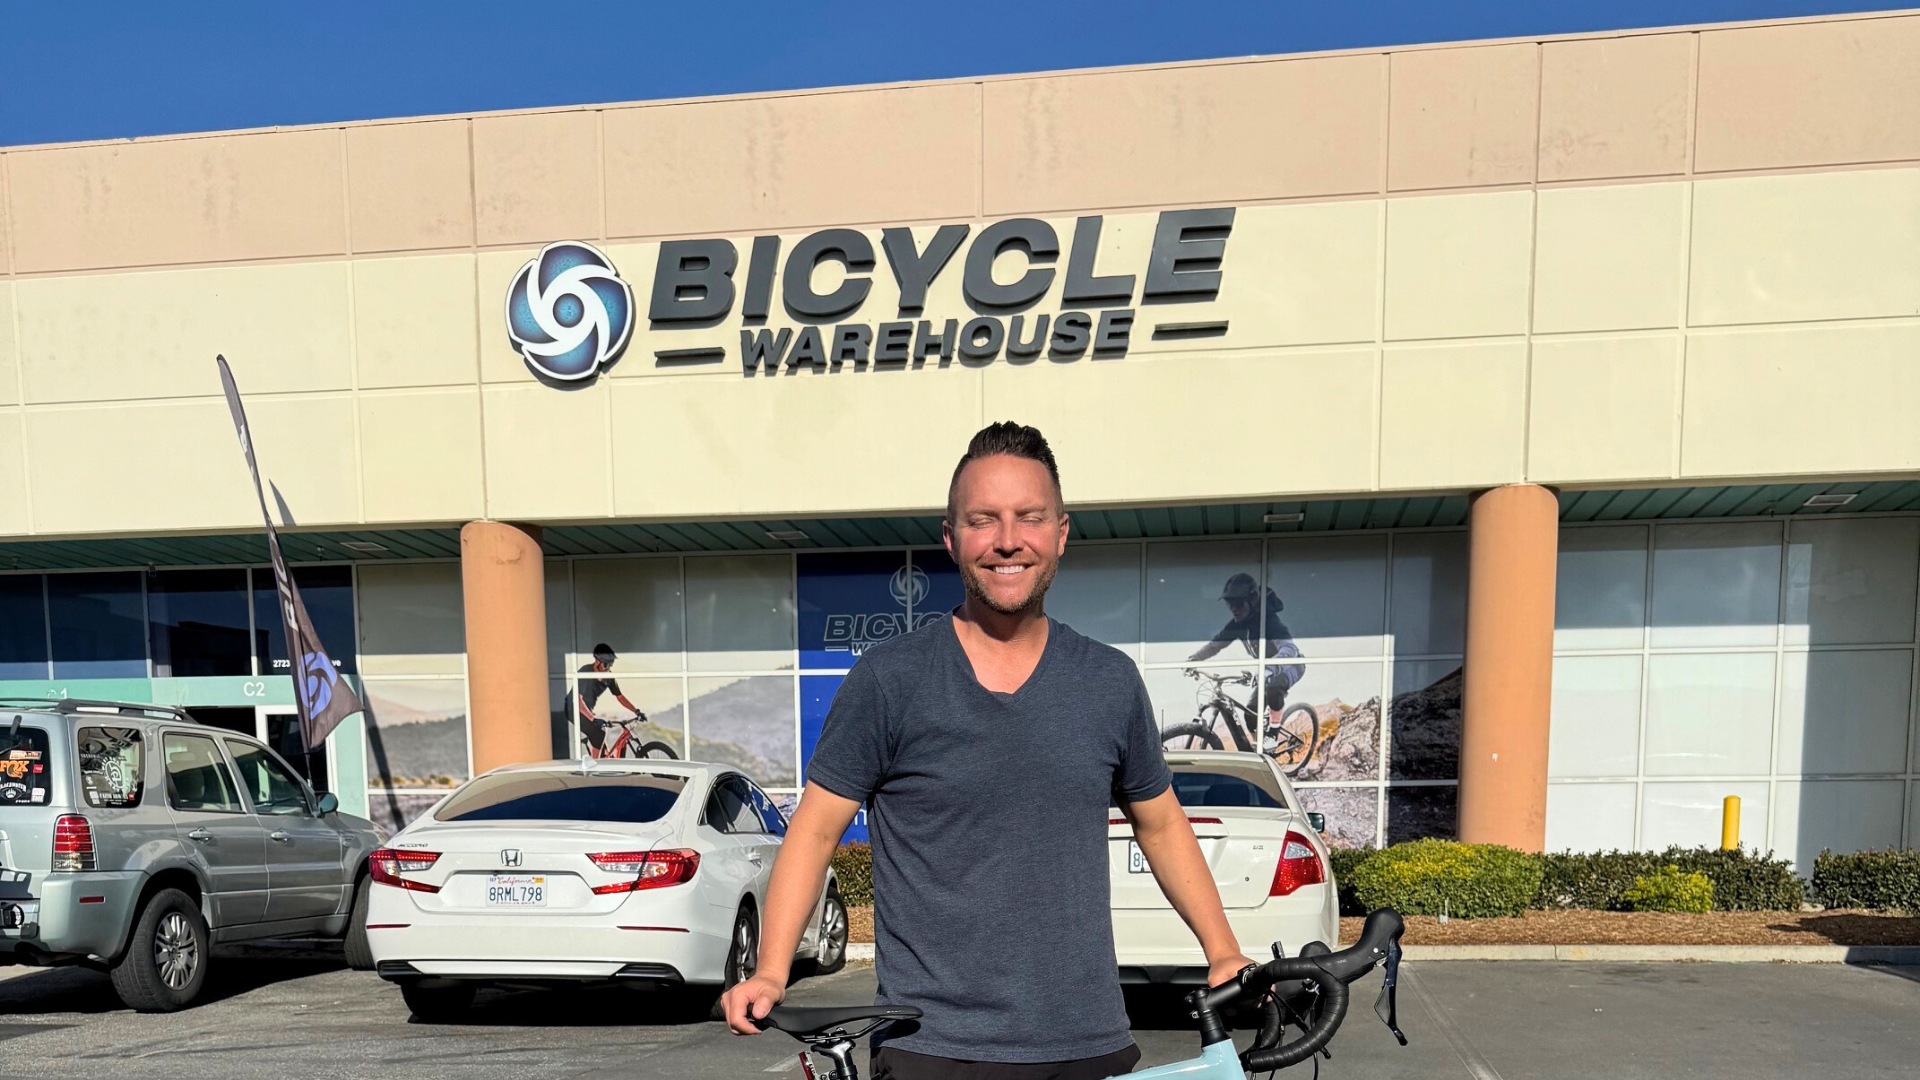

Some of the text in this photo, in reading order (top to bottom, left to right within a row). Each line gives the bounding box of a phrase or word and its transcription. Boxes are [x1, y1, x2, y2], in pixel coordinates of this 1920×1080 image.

[648, 207, 1236, 328] BICYCLE
[740, 308, 1135, 376] WAREHOUSE
[273, 659, 291, 668] 2723
[243, 681, 266, 698] C2
[489, 886, 543, 902] 8RML798
